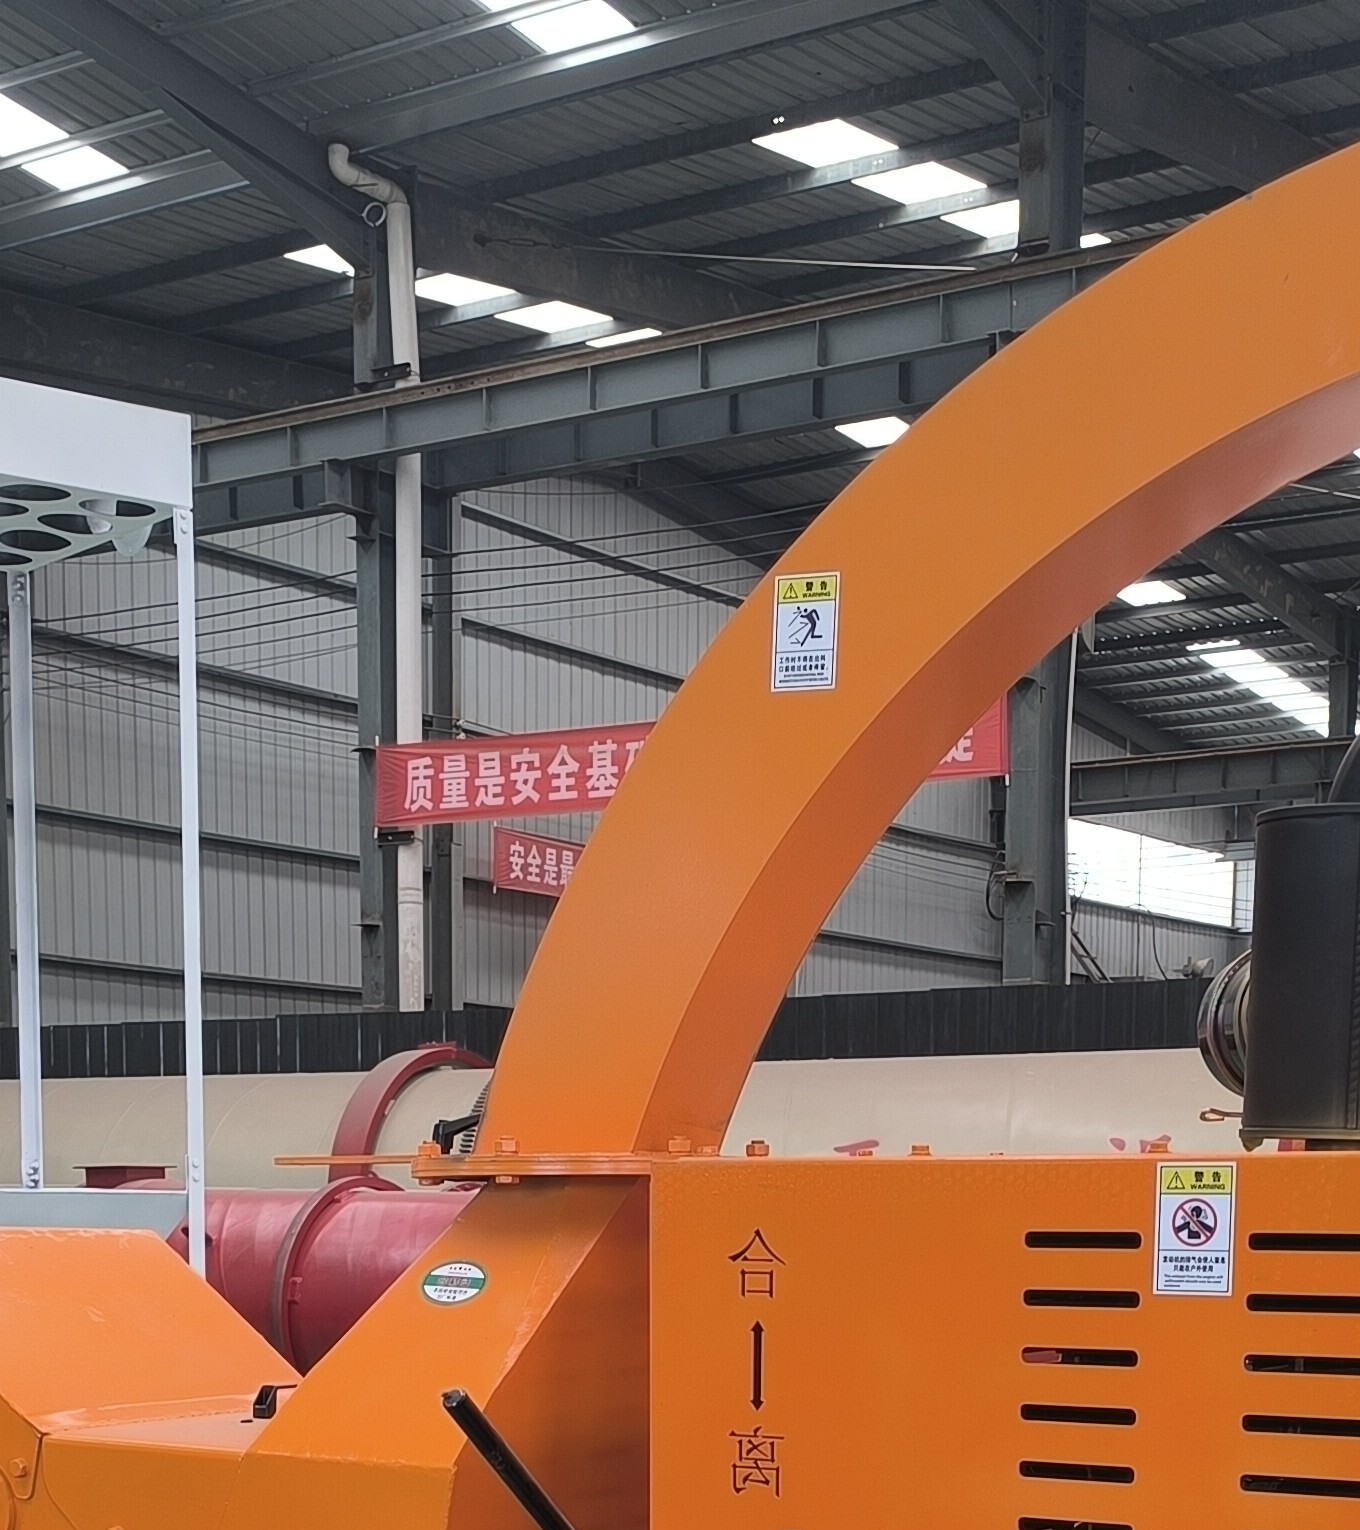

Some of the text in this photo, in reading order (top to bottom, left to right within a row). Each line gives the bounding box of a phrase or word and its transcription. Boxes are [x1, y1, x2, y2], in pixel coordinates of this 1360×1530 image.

[1190, 1183, 1226, 1191] WARNING
[1194, 1171, 1222, 1183] 警告
[728, 1228, 787, 1299] 合
[729, 1425, 785, 1498] 离
